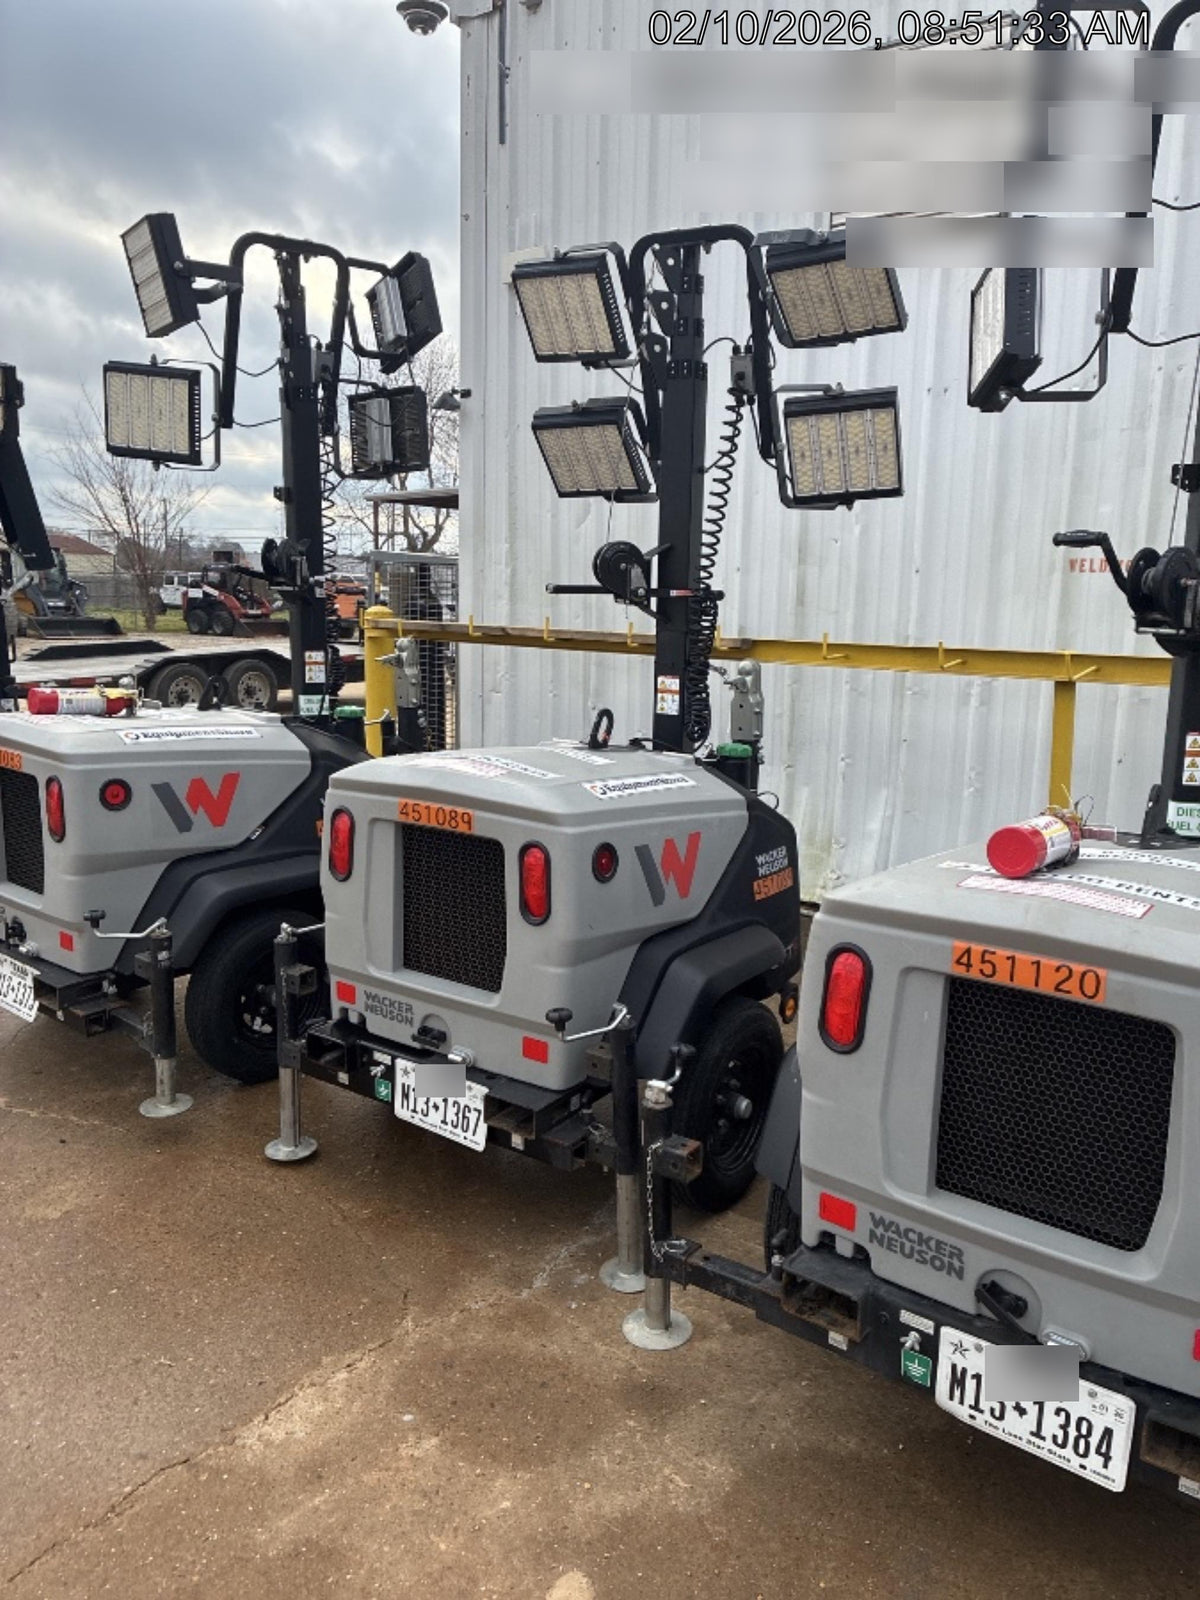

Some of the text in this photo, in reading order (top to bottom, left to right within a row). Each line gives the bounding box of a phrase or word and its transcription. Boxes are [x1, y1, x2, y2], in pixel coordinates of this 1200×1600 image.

[399, 802, 472, 831] 451089
[955, 946, 1101, 999] 451120
[364, 990, 414, 1016] WACKER
[365, 1001, 413, 1028] NEUSON
[869, 1212, 964, 1265] WACKER
[869, 1228, 964, 1280] NEUSON
